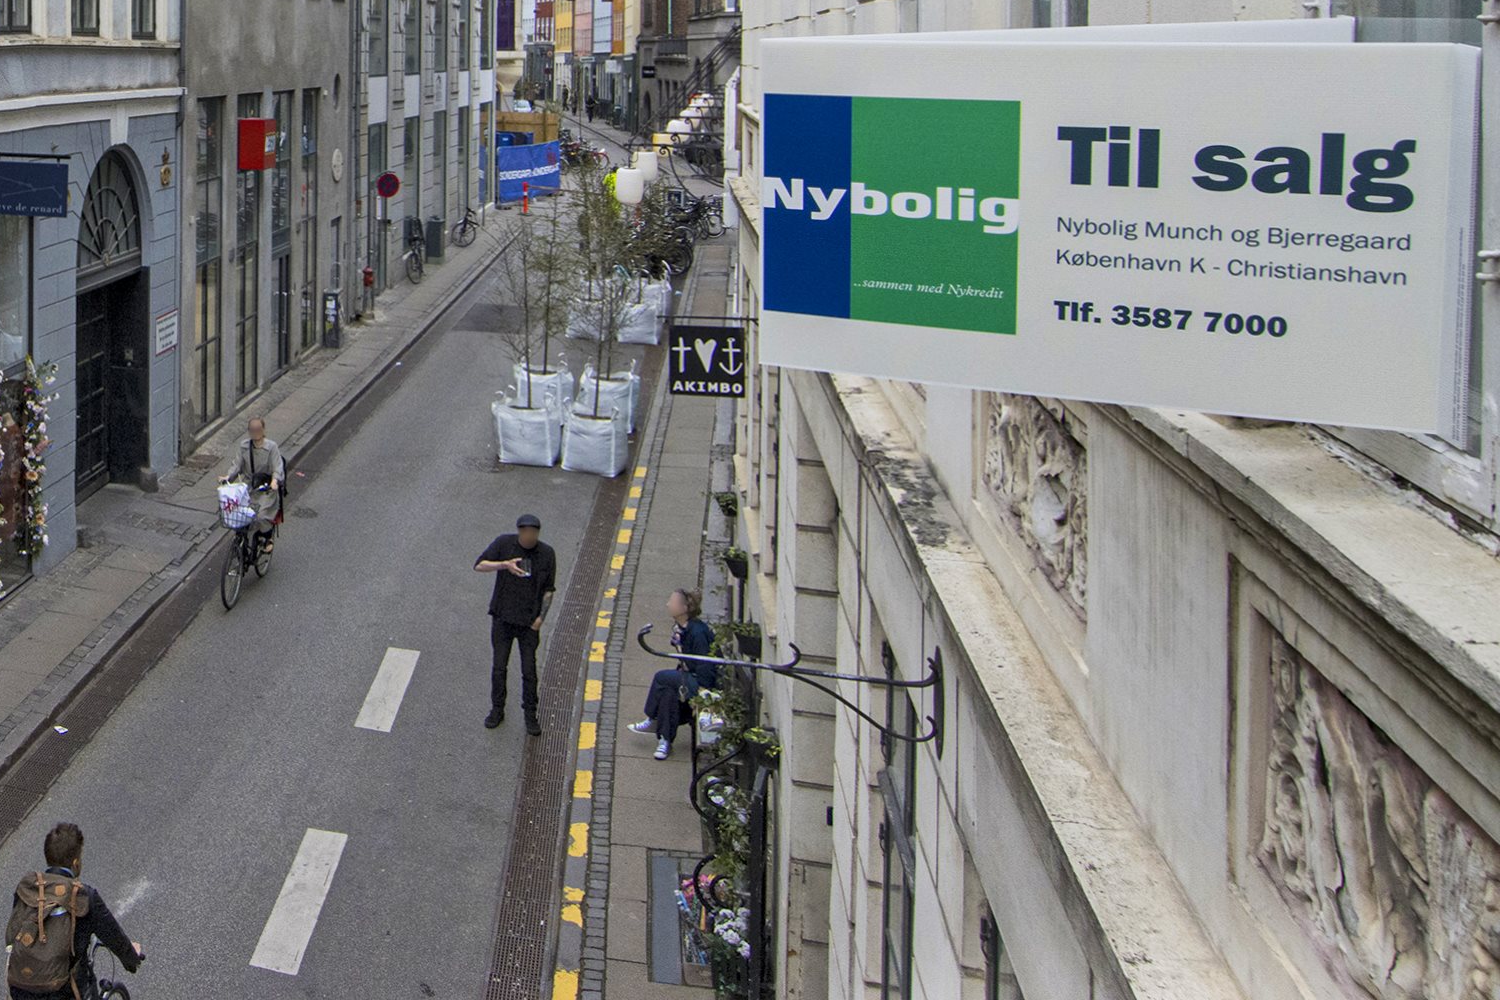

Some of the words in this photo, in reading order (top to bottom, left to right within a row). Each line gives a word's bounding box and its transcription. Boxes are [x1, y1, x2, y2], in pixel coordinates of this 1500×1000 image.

[1057, 125, 1161, 189] Til
[1191, 132, 1417, 213] salg
[15, 203, 27, 212] de
[30, 205, 63, 214] renard
[763, 176, 1019, 235] Nybolig
[1056, 216, 1138, 241] Nybolig
[1144, 220, 1223, 242] Munch
[1230, 228, 1260, 248] og
[1267, 226, 1412, 253] Bjerregaard
[1056, 249, 1181, 273] København
[1190, 257, 1206, 275] K
[1227, 258, 1408, 286] Christianshavn
[916, 283, 944, 295] med
[947, 283, 1005, 300] Nykredit
[1054, 300, 1102, 324] Tlf.
[1111, 304, 1193, 330] 3587
[1203, 311, 1289, 338] 7000
[672, 380, 744, 395] AKIMBO
